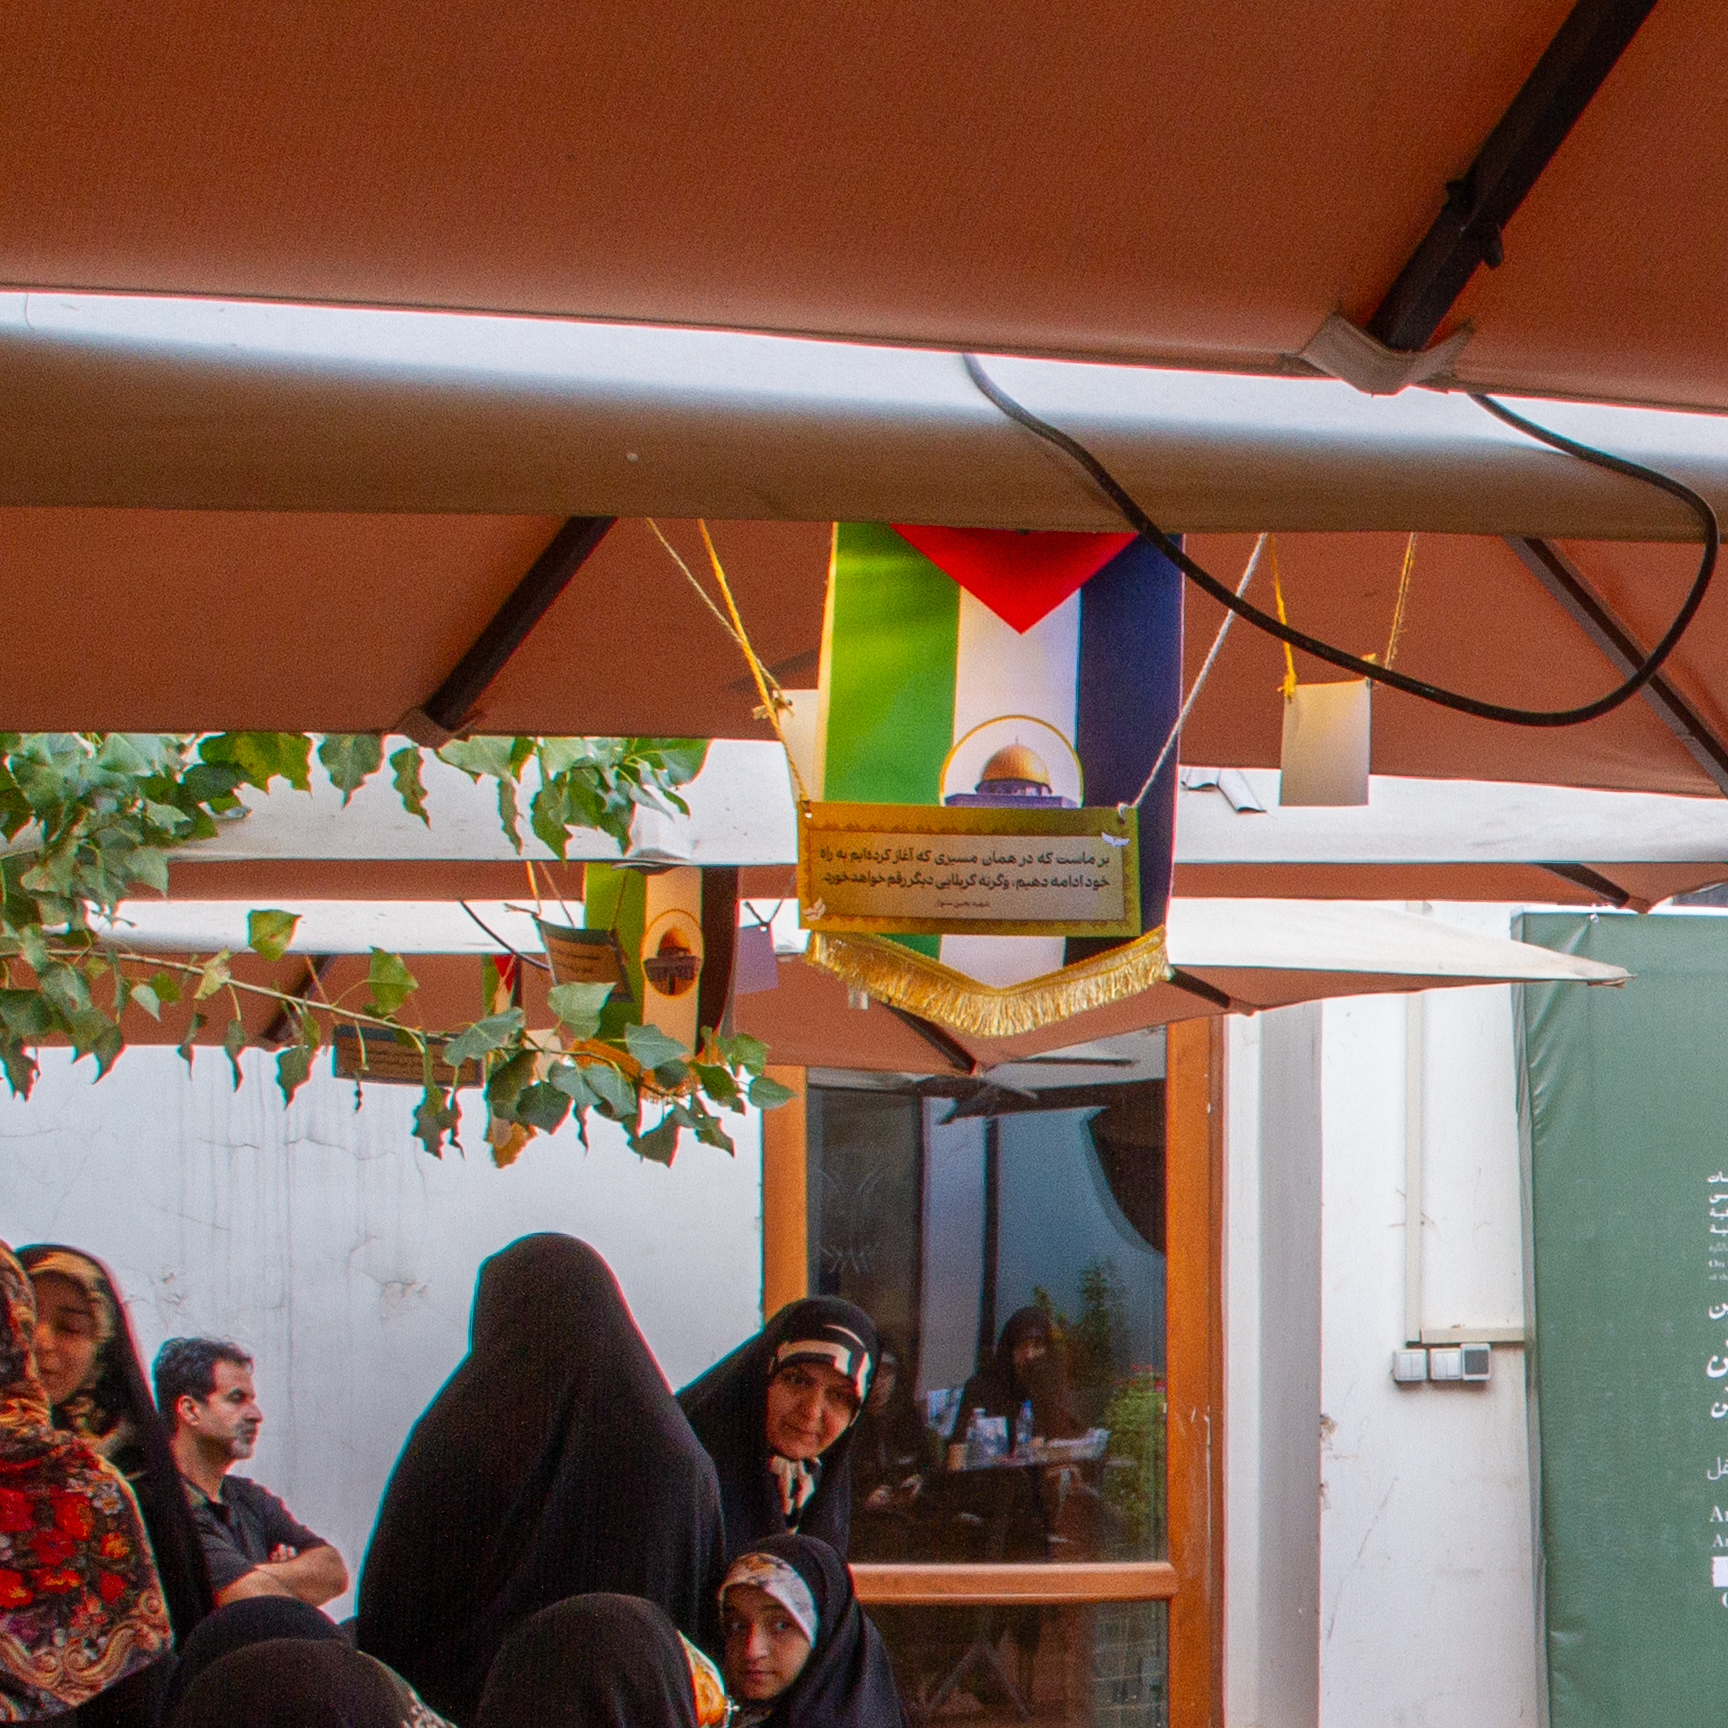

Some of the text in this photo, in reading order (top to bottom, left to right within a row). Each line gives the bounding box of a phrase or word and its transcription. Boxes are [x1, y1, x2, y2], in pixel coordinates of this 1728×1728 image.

[915, 849, 931, 862] که
[981, 849, 1016, 866] همان
[1018, 854, 1033, 867] در
[1036, 850, 1053, 864] که
[1055, 851, 1096, 865] ماست
[1096, 855, 1111, 867] بر
[1708, 1258, 1725, 1267] On
